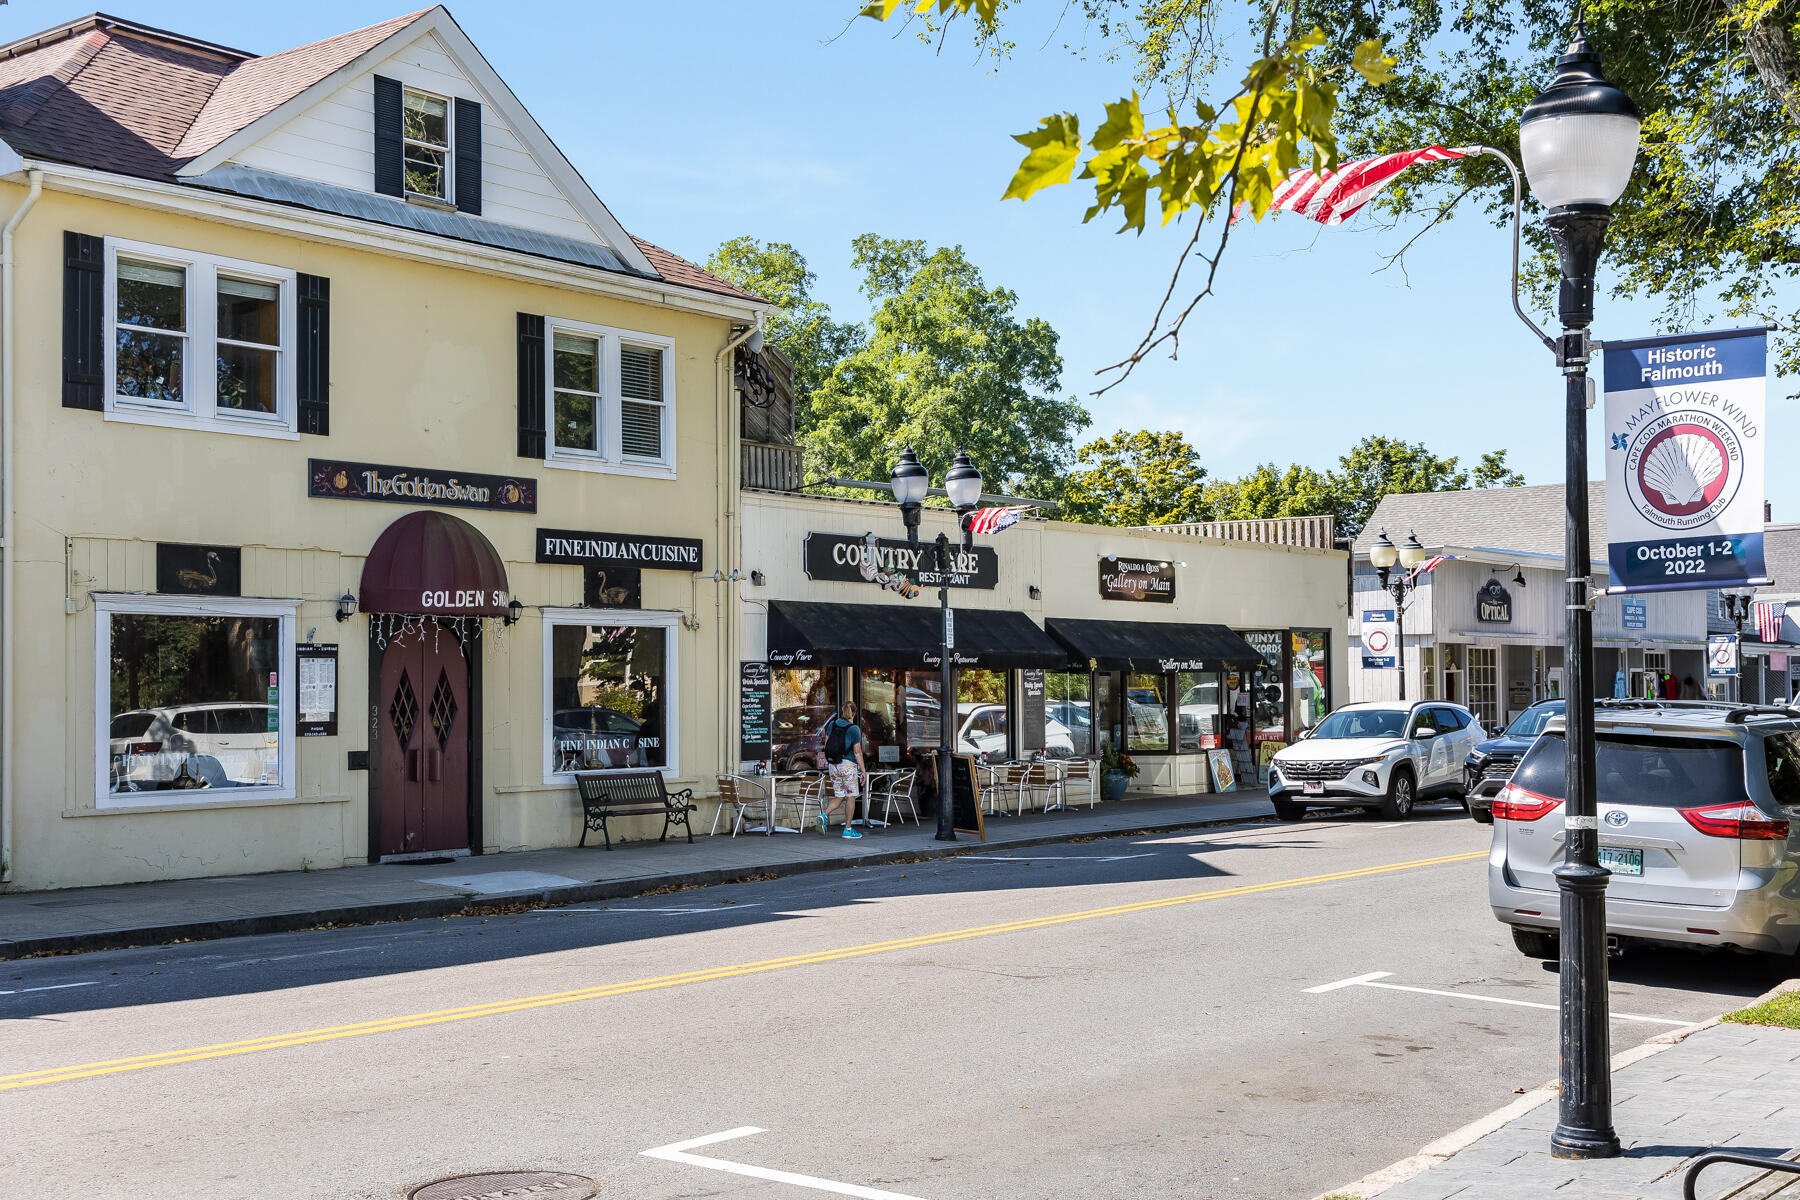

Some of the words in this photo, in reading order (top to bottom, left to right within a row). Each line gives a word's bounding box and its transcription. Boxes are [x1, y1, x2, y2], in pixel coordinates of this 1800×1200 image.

[1648, 344, 1716, 364] Historic
[1641, 360, 1722, 382] Falmouth
[1625, 390, 1718, 430] MAYFLOWER
[1722, 399, 1757, 439] WIND
[1629, 447, 1641, 470] CAPE
[1640, 427, 1656, 445] COD
[1657, 414, 1711, 429] MARATHON
[1712, 421, 1738, 461] WEEKEND
[362, 470, 393, 496] The
[391, 472, 447, 500] Golden
[446, 478, 490, 502] Swan
[1642, 503, 1676, 525] Falmouth
[1677, 511, 1711, 526] Running
[1709, 497, 1726, 514] Club
[545, 538, 584, 556] FINE
[583, 540, 639, 559] INDIAN
[640, 543, 698, 563] CUISINE
[833, 542, 923, 571] COUNTRY
[1637, 543, 1704, 561] October
[1708, 541, 1732, 555] 1-2
[1665, 559, 1706, 575] 2022
[1107, 573, 1137, 593] Gallery
[1139, 580, 1147, 590] on
[1150, 577, 1171, 591] Main
[421, 590, 485, 608] GOLDEN
[1481, 602, 1509, 621] OPTICAL
[1246, 633, 1282, 643] VINYL
[770, 649, 794, 666] Country
[795, 649, 813, 661] Fare
[1251, 644, 1282, 654] ECORDS
[923, 652, 941, 667] Country
[1161, 658, 1180, 673] Gallery
[1181, 662, 1188, 670] on
[1188, 659, 1203, 670] Main
[560, 740, 584, 752] FINE
[586, 738, 621, 751] INDIAN
[1617, 853, 1641, 867] 2106
